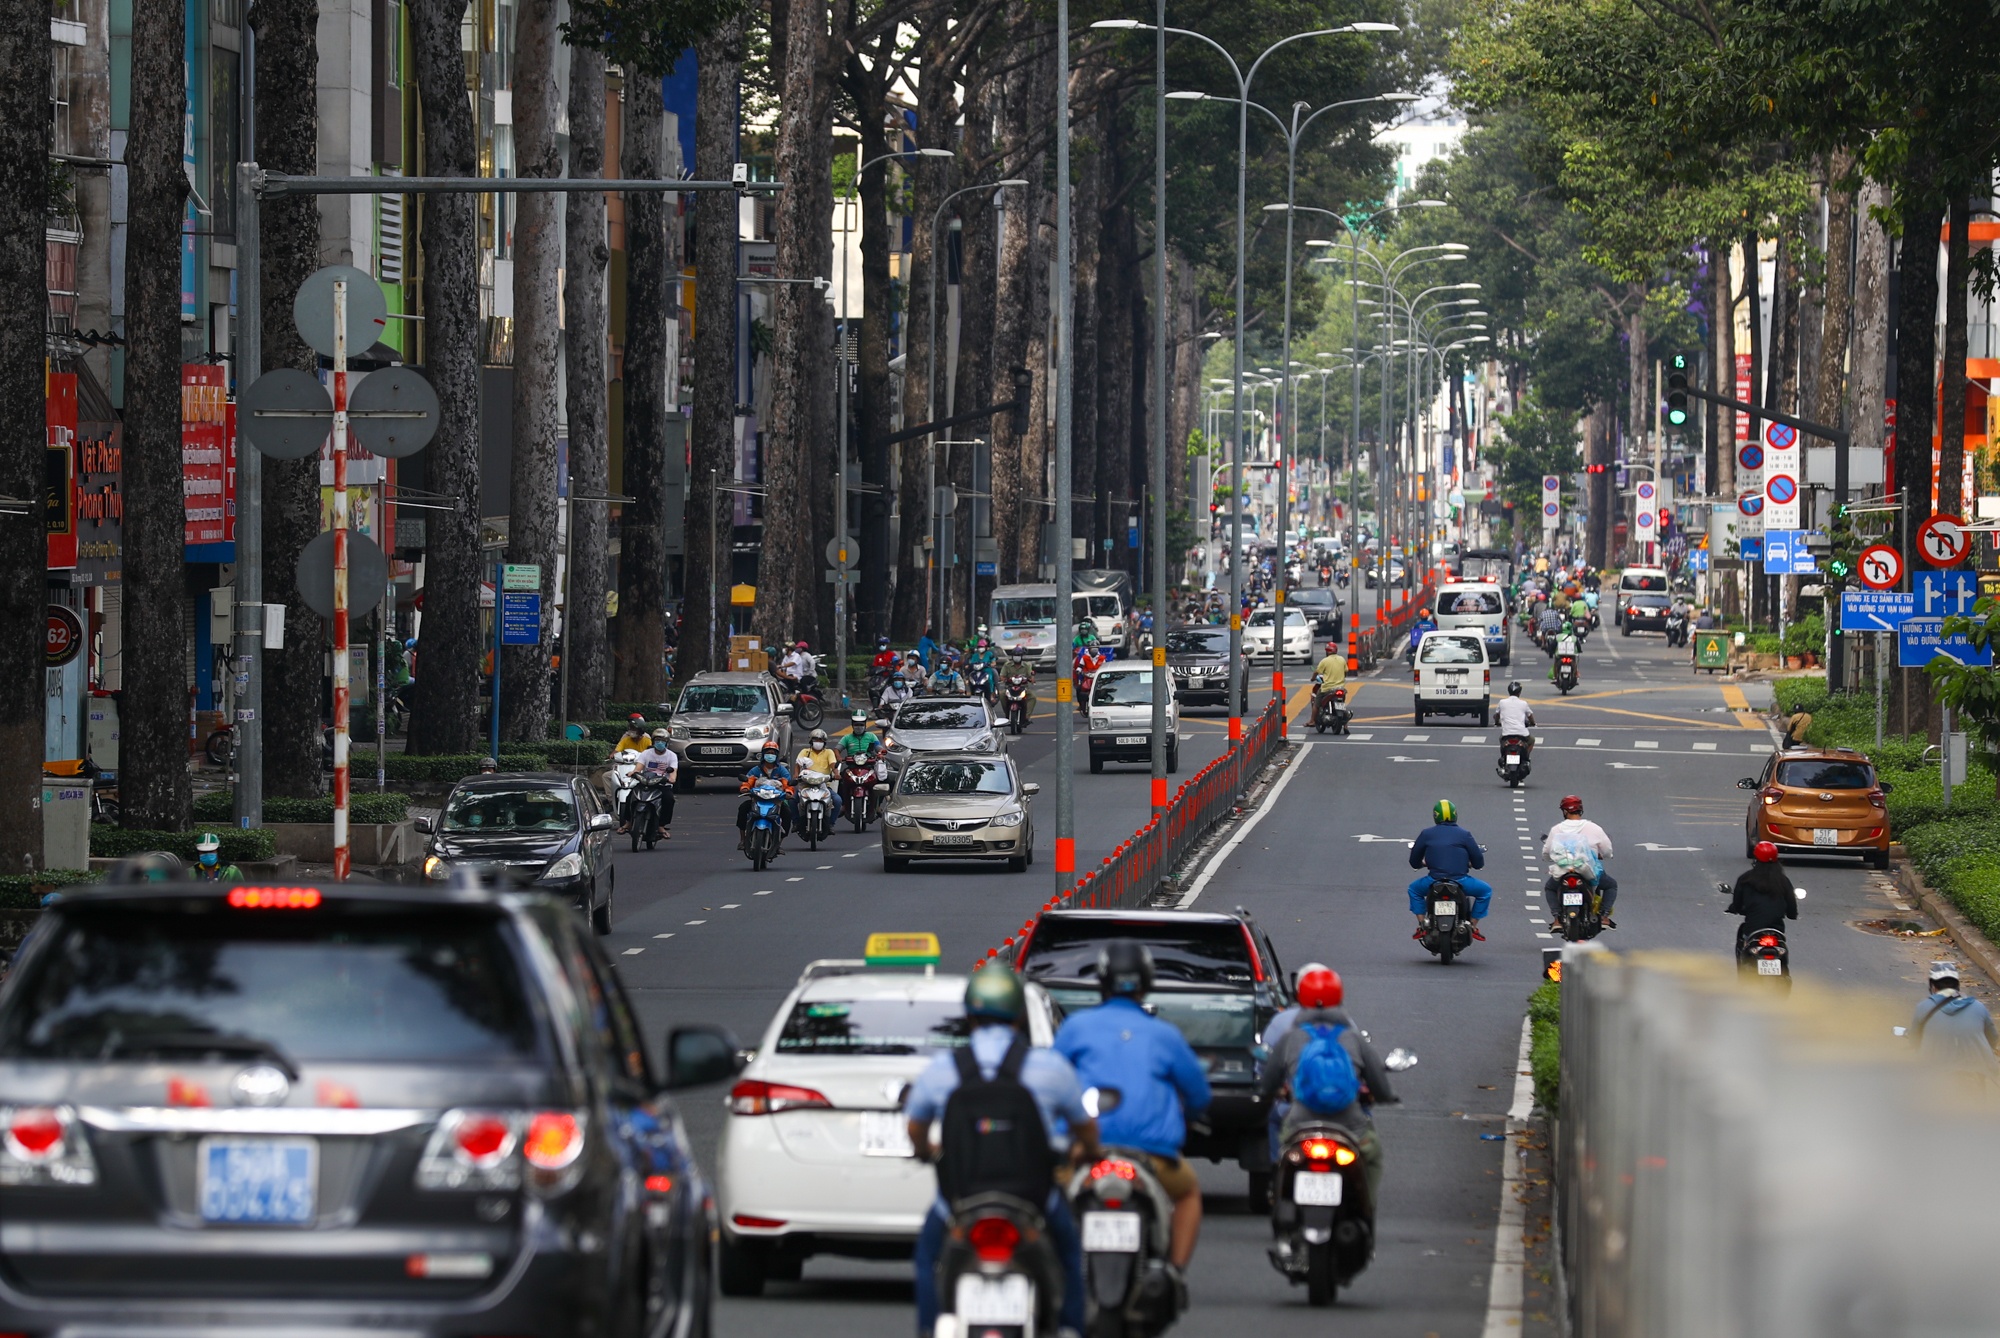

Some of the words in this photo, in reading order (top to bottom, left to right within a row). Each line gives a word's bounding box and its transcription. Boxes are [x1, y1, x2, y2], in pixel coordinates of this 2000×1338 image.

[1675, 355, 1685, 368] 15
[77, 486, 103, 527] Phong
[1845, 593, 1862, 603] HƯỚNG
[1863, 595, 1870, 603] XE
[1871, 595, 1878, 603] 02
[1848, 603, 1857, 612] VÀO
[1859, 603, 1876, 613] ĐƯỜNG
[1887, 605, 1897, 615] VẠN
[1902, 622, 1922, 633] HƯỚNG
[1925, 624, 1932, 633] XE
[47, 628, 67, 644] 62
[1907, 634, 1918, 645] VÀO
[1921, 634, 1941, 645] ĐƯỜNG
[1955, 636, 1967, 646] VẠN
[1820, 829, 1832, 837] 51F
[935, 835, 971, 844] 52U-9305
